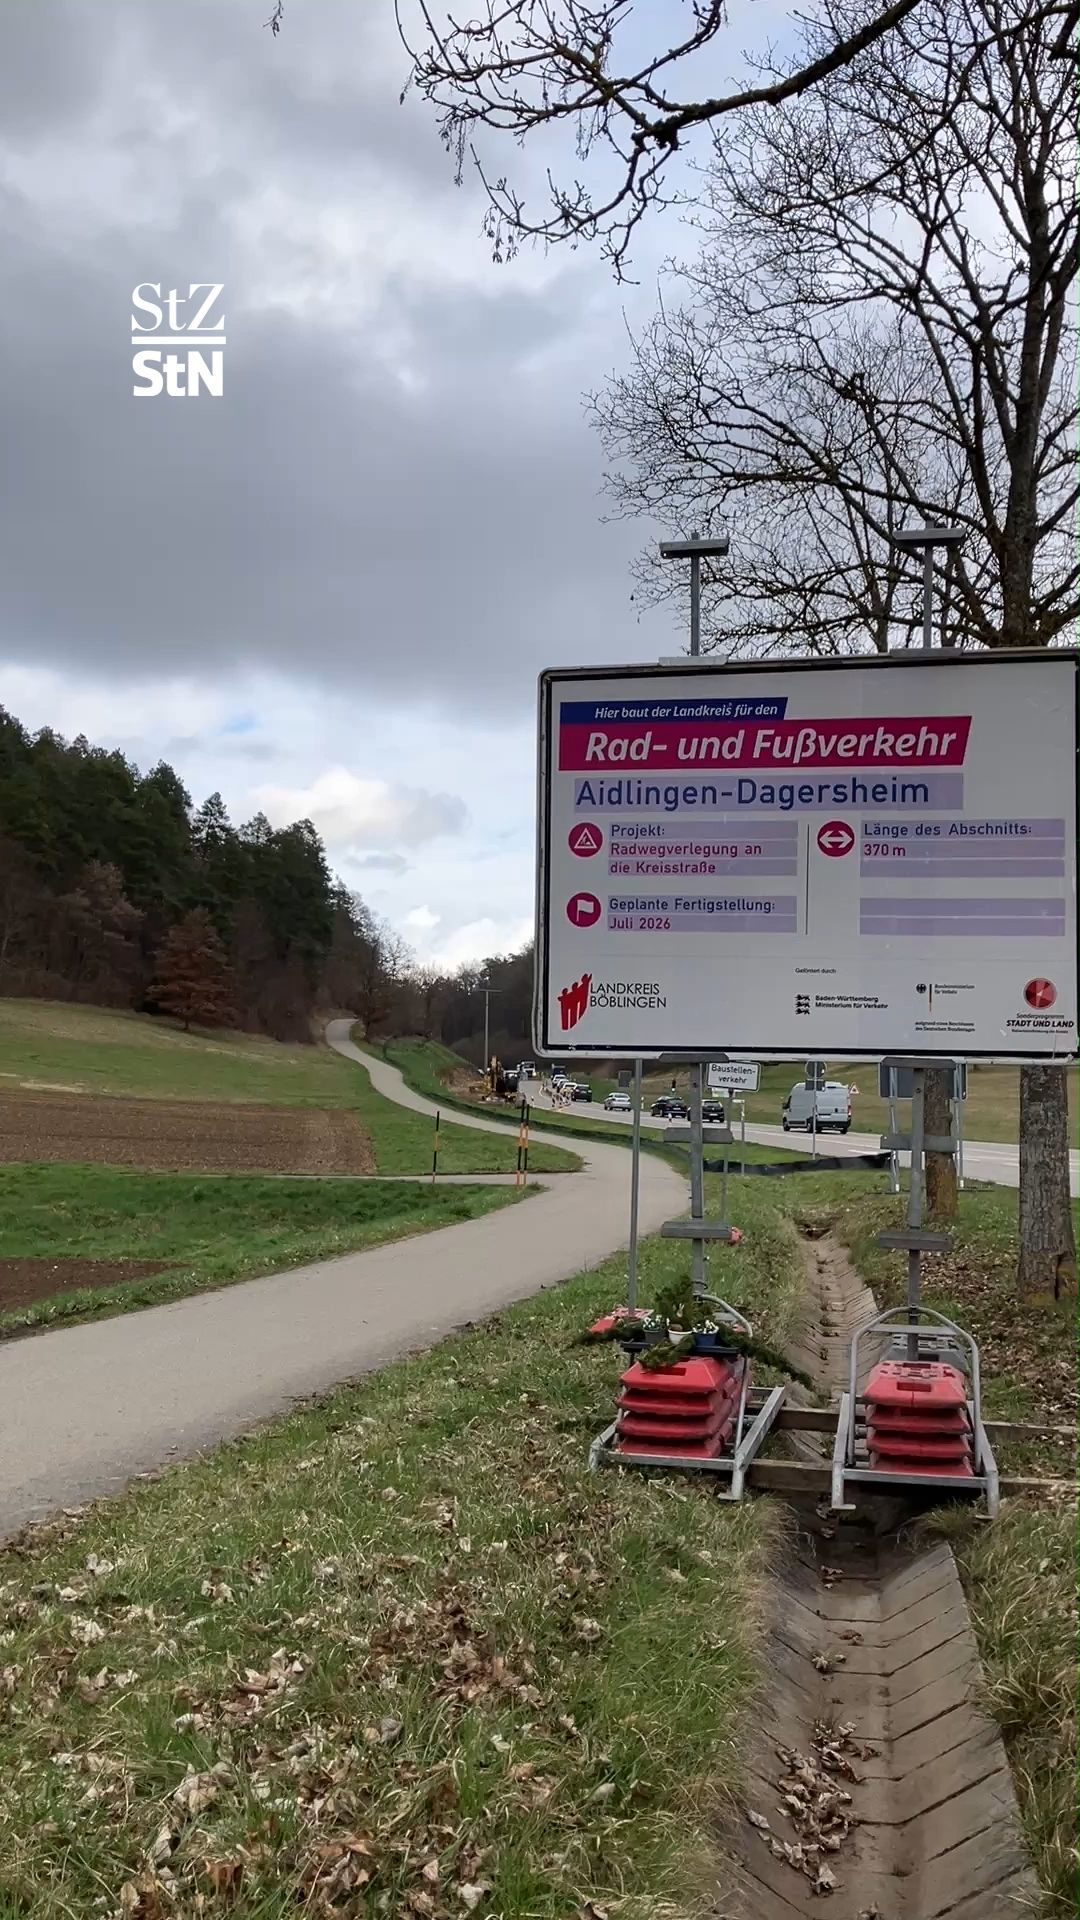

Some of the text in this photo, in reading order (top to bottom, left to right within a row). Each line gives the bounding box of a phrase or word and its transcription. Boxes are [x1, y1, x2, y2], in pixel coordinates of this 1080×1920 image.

[595, 704, 778, 719] Hier baut der Landkreis für den
[585, 726, 957, 764] Rad- und Fußverkehr
[575, 776, 930, 811] Aidlingen-Dagersheim
[610, 824, 665, 840] Projekt:
[863, 821, 1032, 838] Länge des Abschnitts:
[610, 842, 762, 858] Radwegverlegung an
[863, 843, 906, 857] 370 m
[610, 861, 716, 874] die Kreisstraße
[609, 897, 775, 913] Geplante Fertigstellung:
[609, 917, 671, 929] Juli 2026
[590, 983, 660, 995] LANDKREIS
[590, 992, 667, 1008] BÖBLINGEN
[815, 995, 879, 1003] Baden-Württemberg
[1006, 1019, 1075, 1028] STADT UND LAND
[711, 1063, 756, 1075] Baustellen-
[718, 1075, 747, 1084] verkehr
